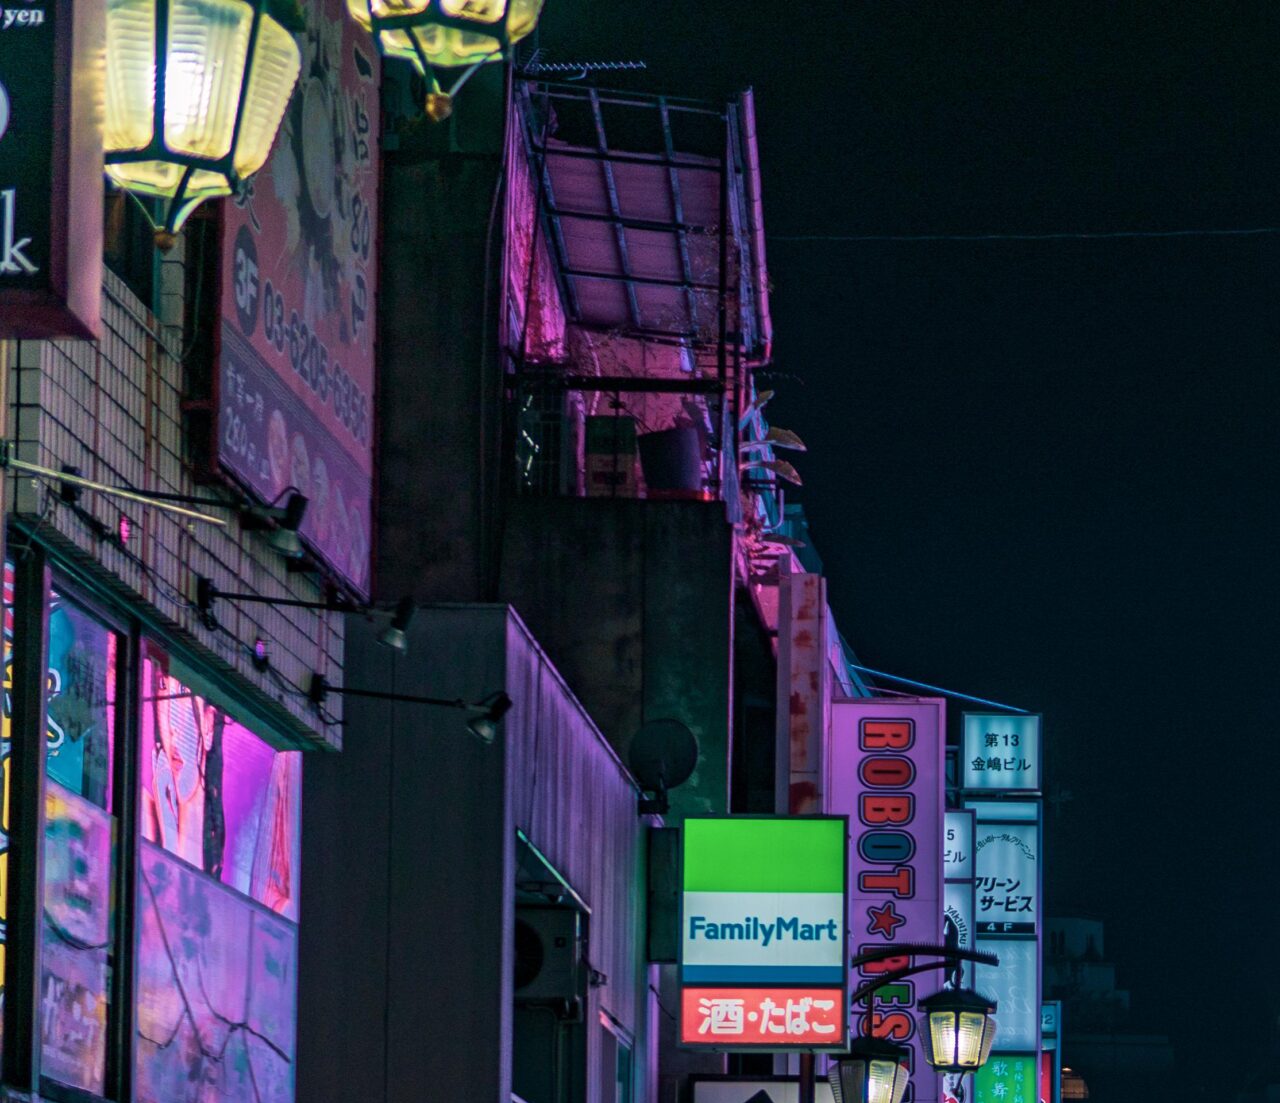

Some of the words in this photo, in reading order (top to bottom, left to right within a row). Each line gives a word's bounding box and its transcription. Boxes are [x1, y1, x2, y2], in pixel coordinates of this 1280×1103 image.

[4, 8, 44, 29] yen
[984, 732, 999, 748] 第
[1003, 733, 1020, 747] 13
[971, 756, 1032, 772] 金嶋ビル
[858, 716, 916, 899] ROBOT
[980, 895, 1034, 913] サービス
[689, 916, 838, 947] FamilyMart
[698, 997, 836, 1035] 酒・たばこ
